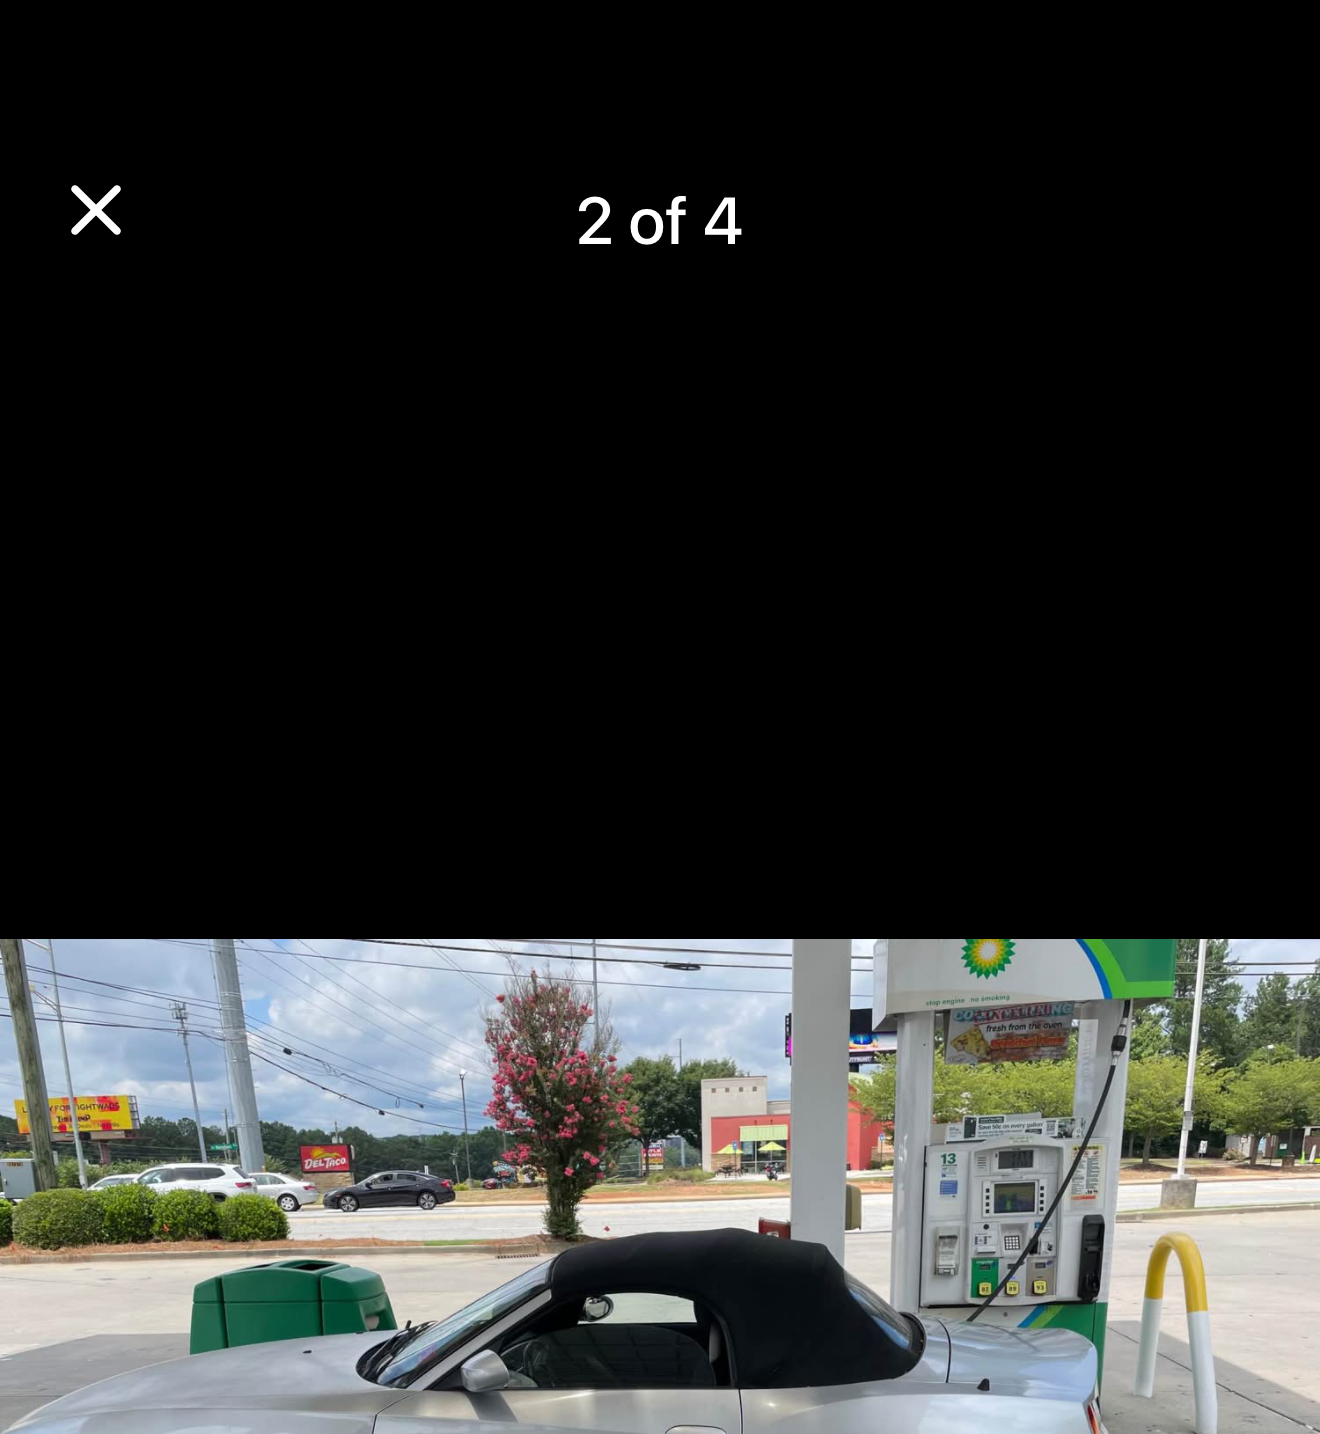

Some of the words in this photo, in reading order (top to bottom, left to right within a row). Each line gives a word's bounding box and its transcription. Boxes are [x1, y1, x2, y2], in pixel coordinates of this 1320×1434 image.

[942, 998, 965, 1006] engine
[986, 1024, 1006, 1032] fresh
[1008, 1023, 1026, 1031] from
[1028, 1021, 1042, 1029] the
[75, 1102, 120, 1111] IGHTWADS
[305, 1158, 324, 1170] DEL
[324, 1157, 347, 1169] TACO
[941, 1153, 956, 1164] 13
